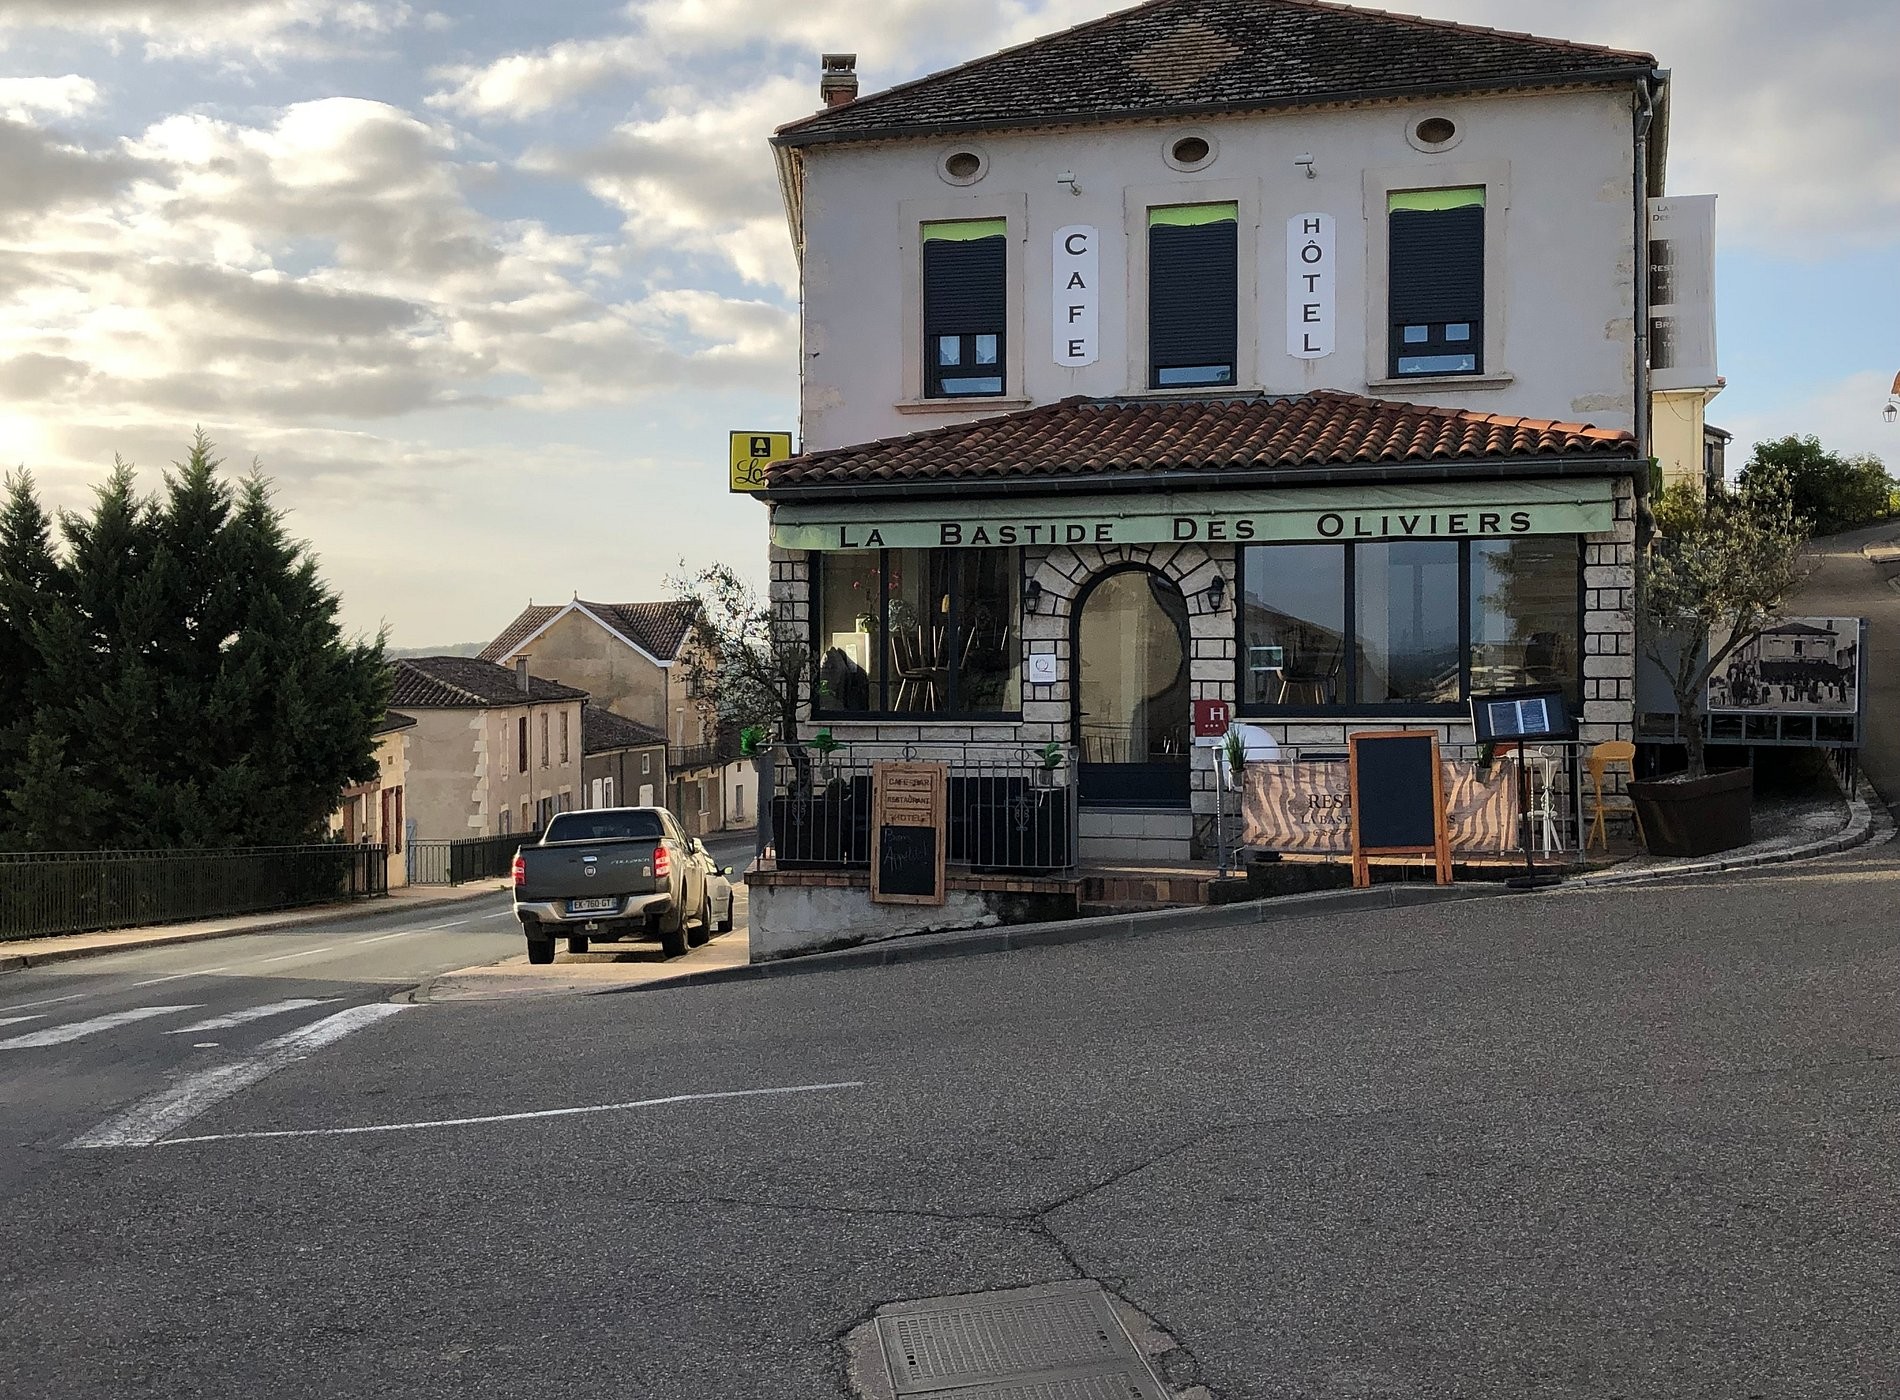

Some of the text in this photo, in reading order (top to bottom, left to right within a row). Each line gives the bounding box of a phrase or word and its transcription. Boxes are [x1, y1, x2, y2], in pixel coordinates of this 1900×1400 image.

[1064, 233, 1088, 357] CAFE
[1301, 218, 1322, 352] HÔTEL
[840, 511, 1532, 548] LA BASTIDE DES OLIVIERS
[1210, 707, 1225, 721] H
